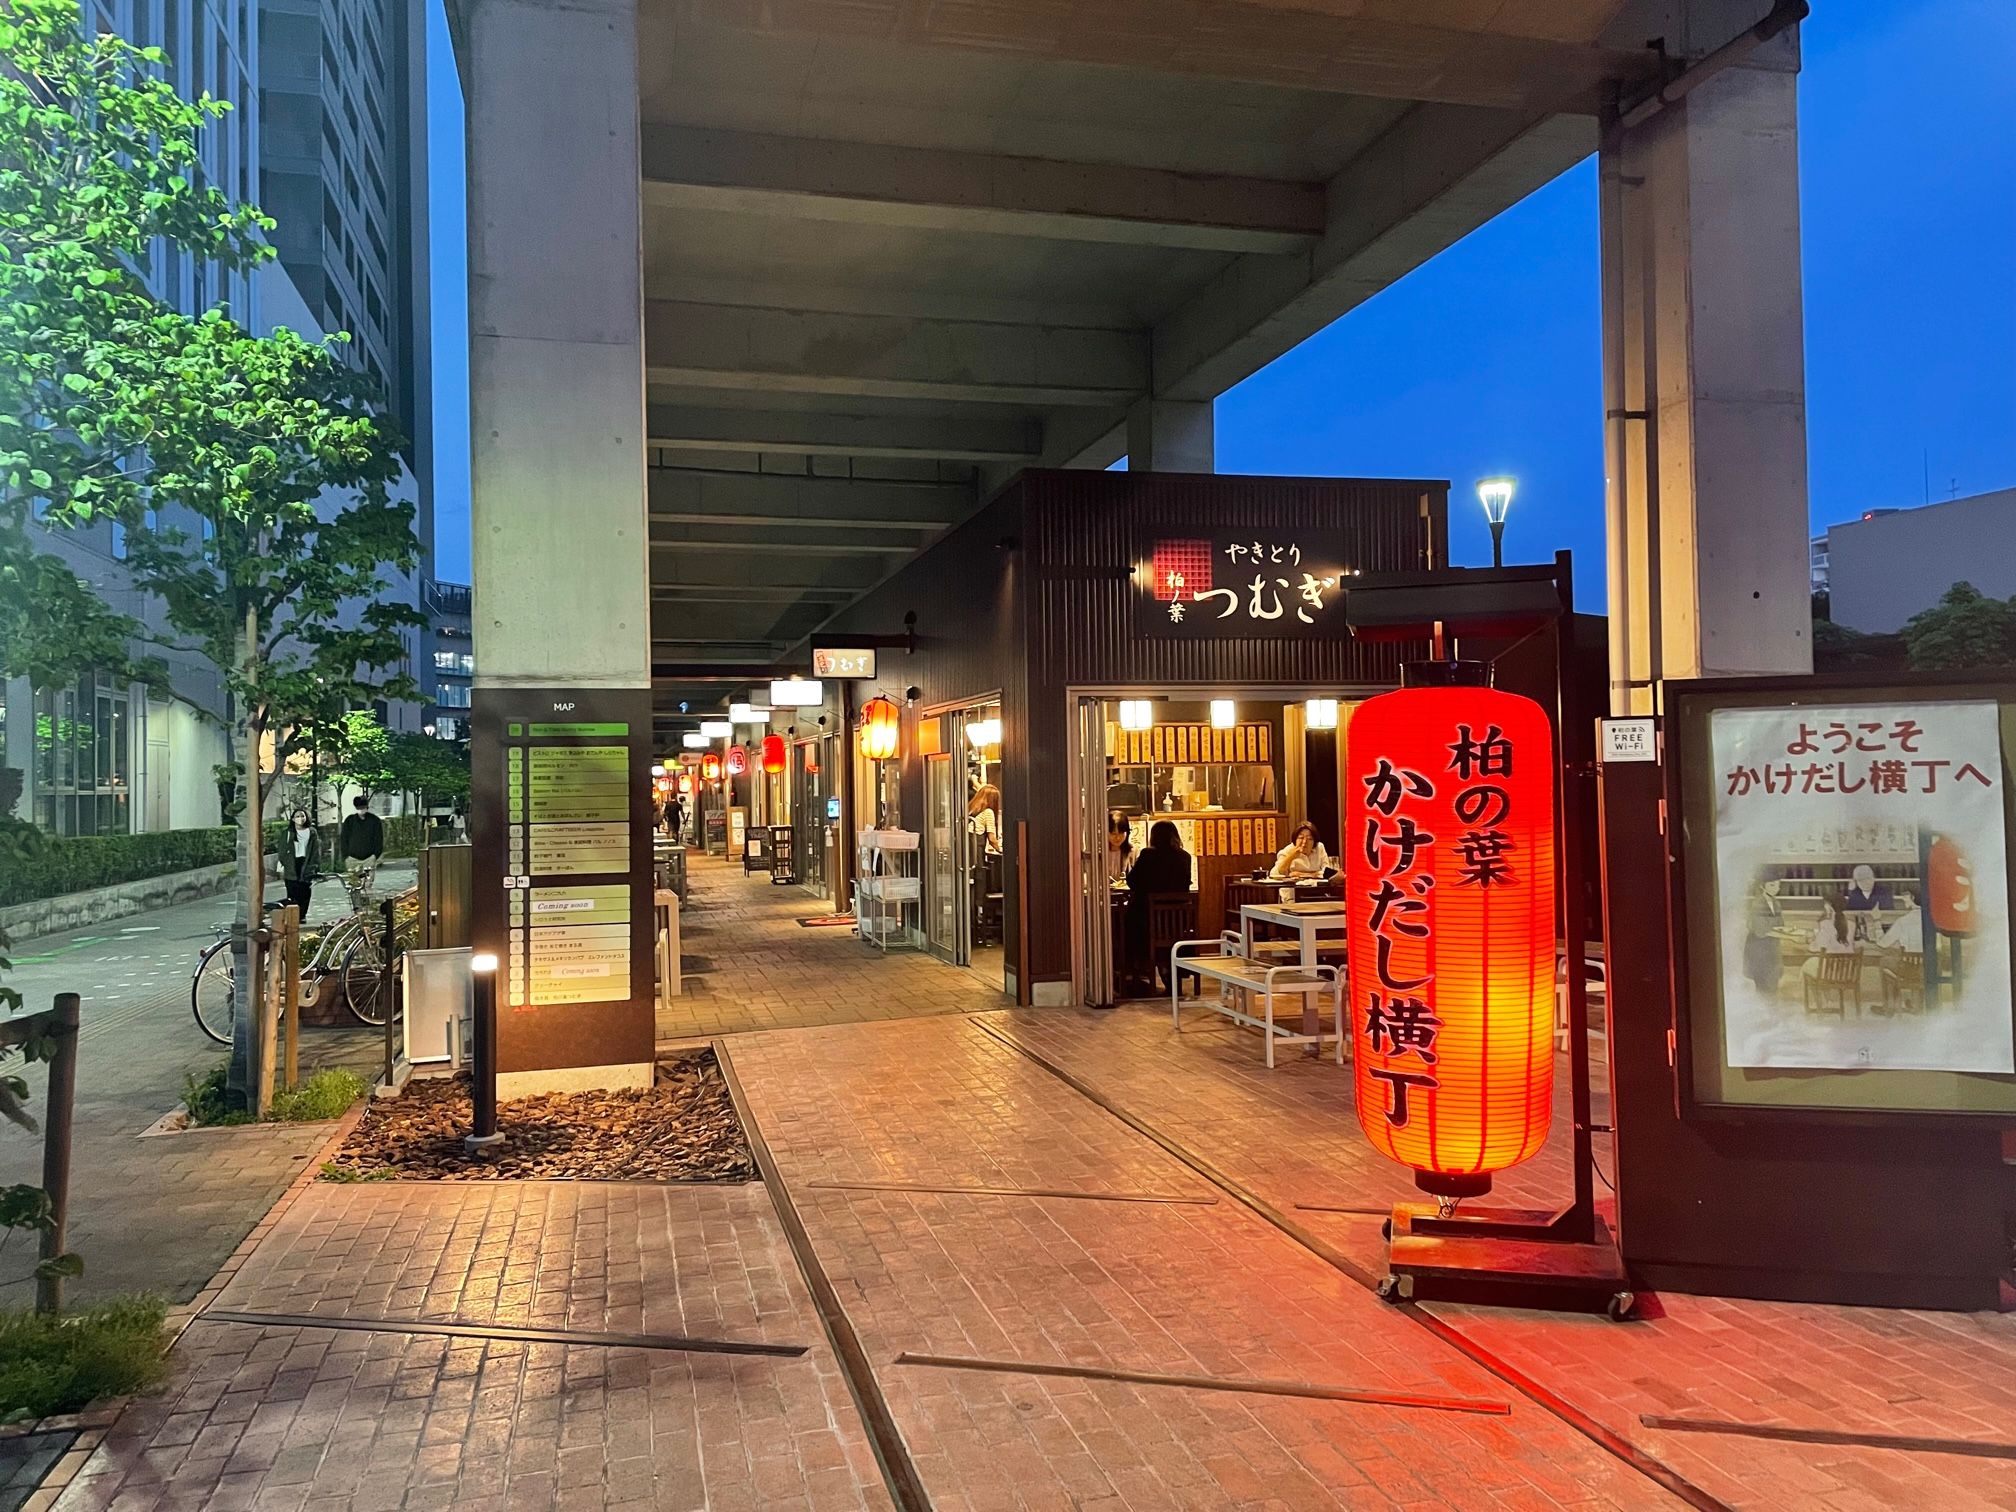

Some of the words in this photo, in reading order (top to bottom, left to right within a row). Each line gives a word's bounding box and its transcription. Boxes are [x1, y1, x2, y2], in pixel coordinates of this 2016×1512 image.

[1224, 541, 1302, 567] やきとり
[1193, 572, 1336, 624] つむぎ
[553, 702, 576, 712] MAP
[1614, 733, 1643, 742] FREE
[1614, 742, 1644, 750] Wi-Fi
[1786, 719, 1925, 756] ようこそ
[1726, 758, 1993, 797] かけだし横丁へ
[1446, 723, 1522, 890] 柏の葉
[537, 902, 569, 910] Coming
[1362, 757, 1445, 1129] かけだし横丁
